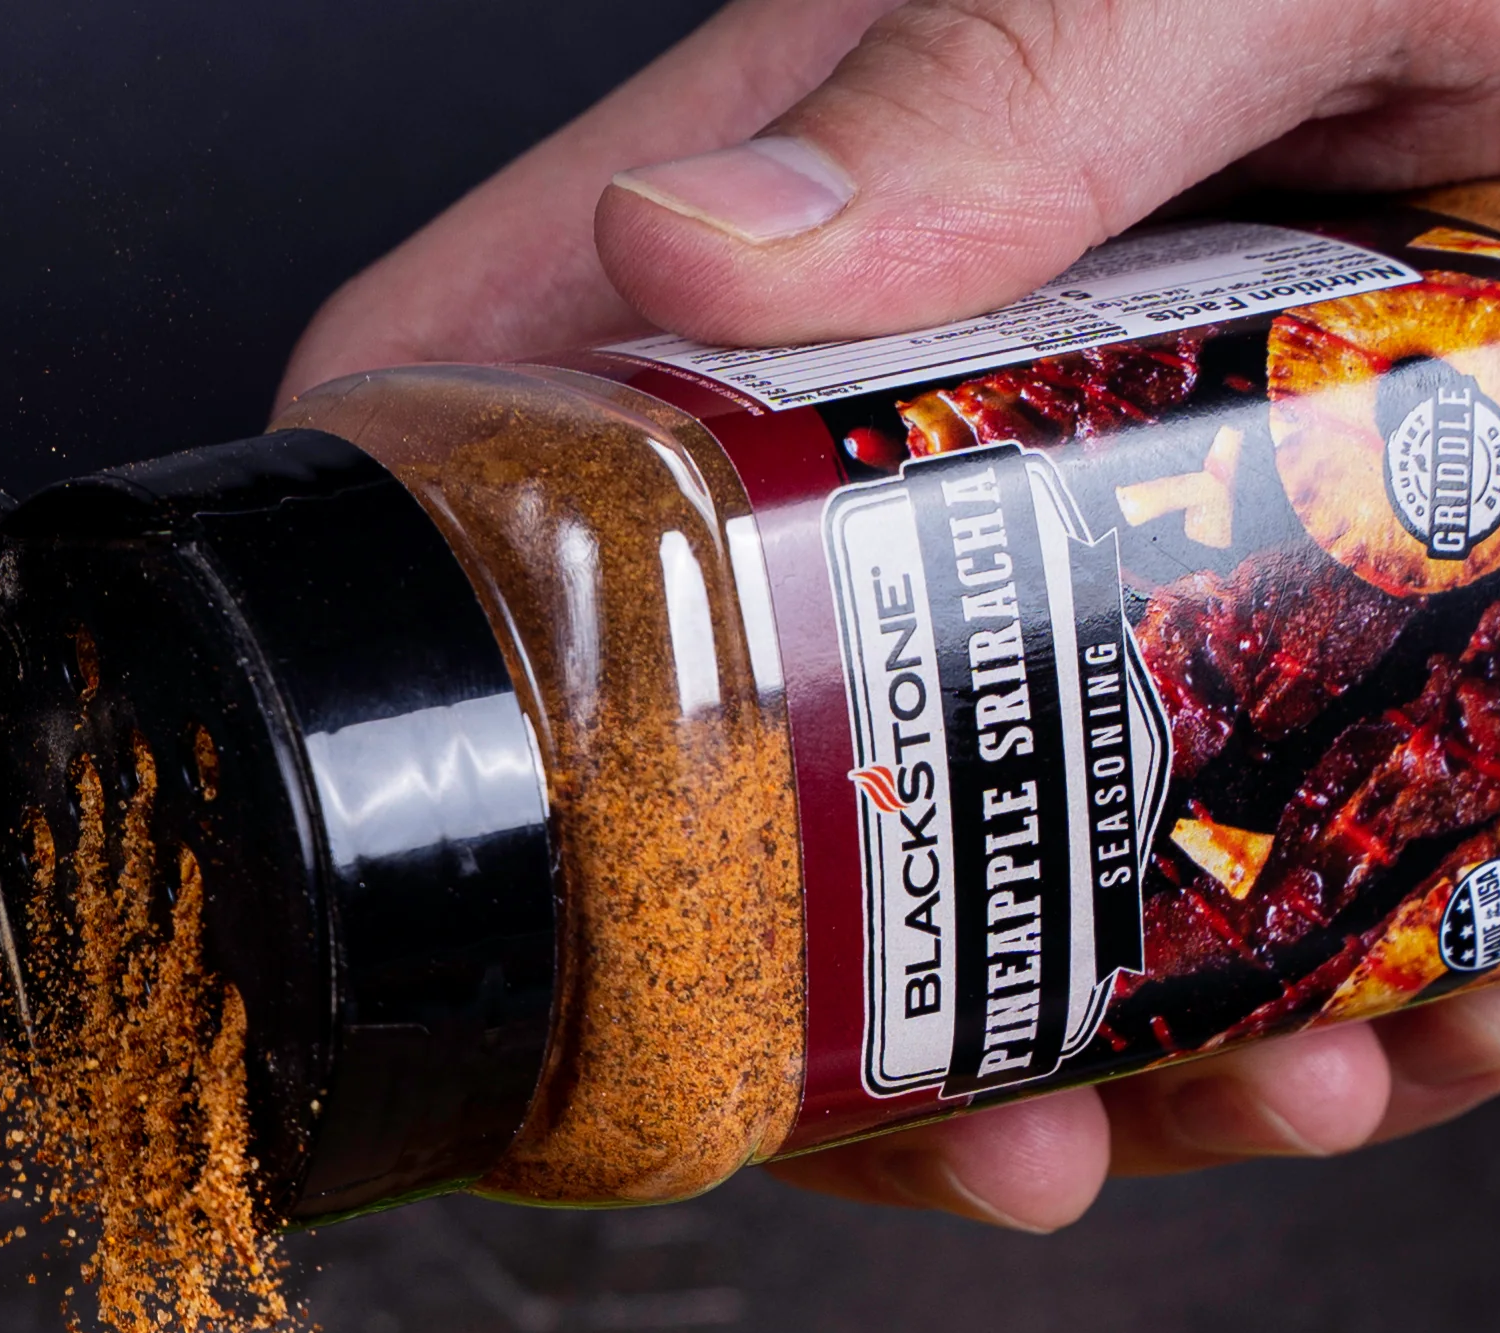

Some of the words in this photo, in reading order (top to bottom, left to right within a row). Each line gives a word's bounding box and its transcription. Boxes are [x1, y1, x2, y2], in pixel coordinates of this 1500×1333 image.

[1059, 290, 1092, 300] 5
[1146, 295, 1249, 322] Facts
[1248, 264, 1406, 302] Nutrition
[1398, 414, 1426, 517] GOURMET
[1433, 387, 1472, 552] GRIDDLE
[941, 466, 1035, 759] SRIRACHA
[1085, 641, 1131, 887] SEASONING
[976, 779, 1042, 1078] PINEAPPLE
